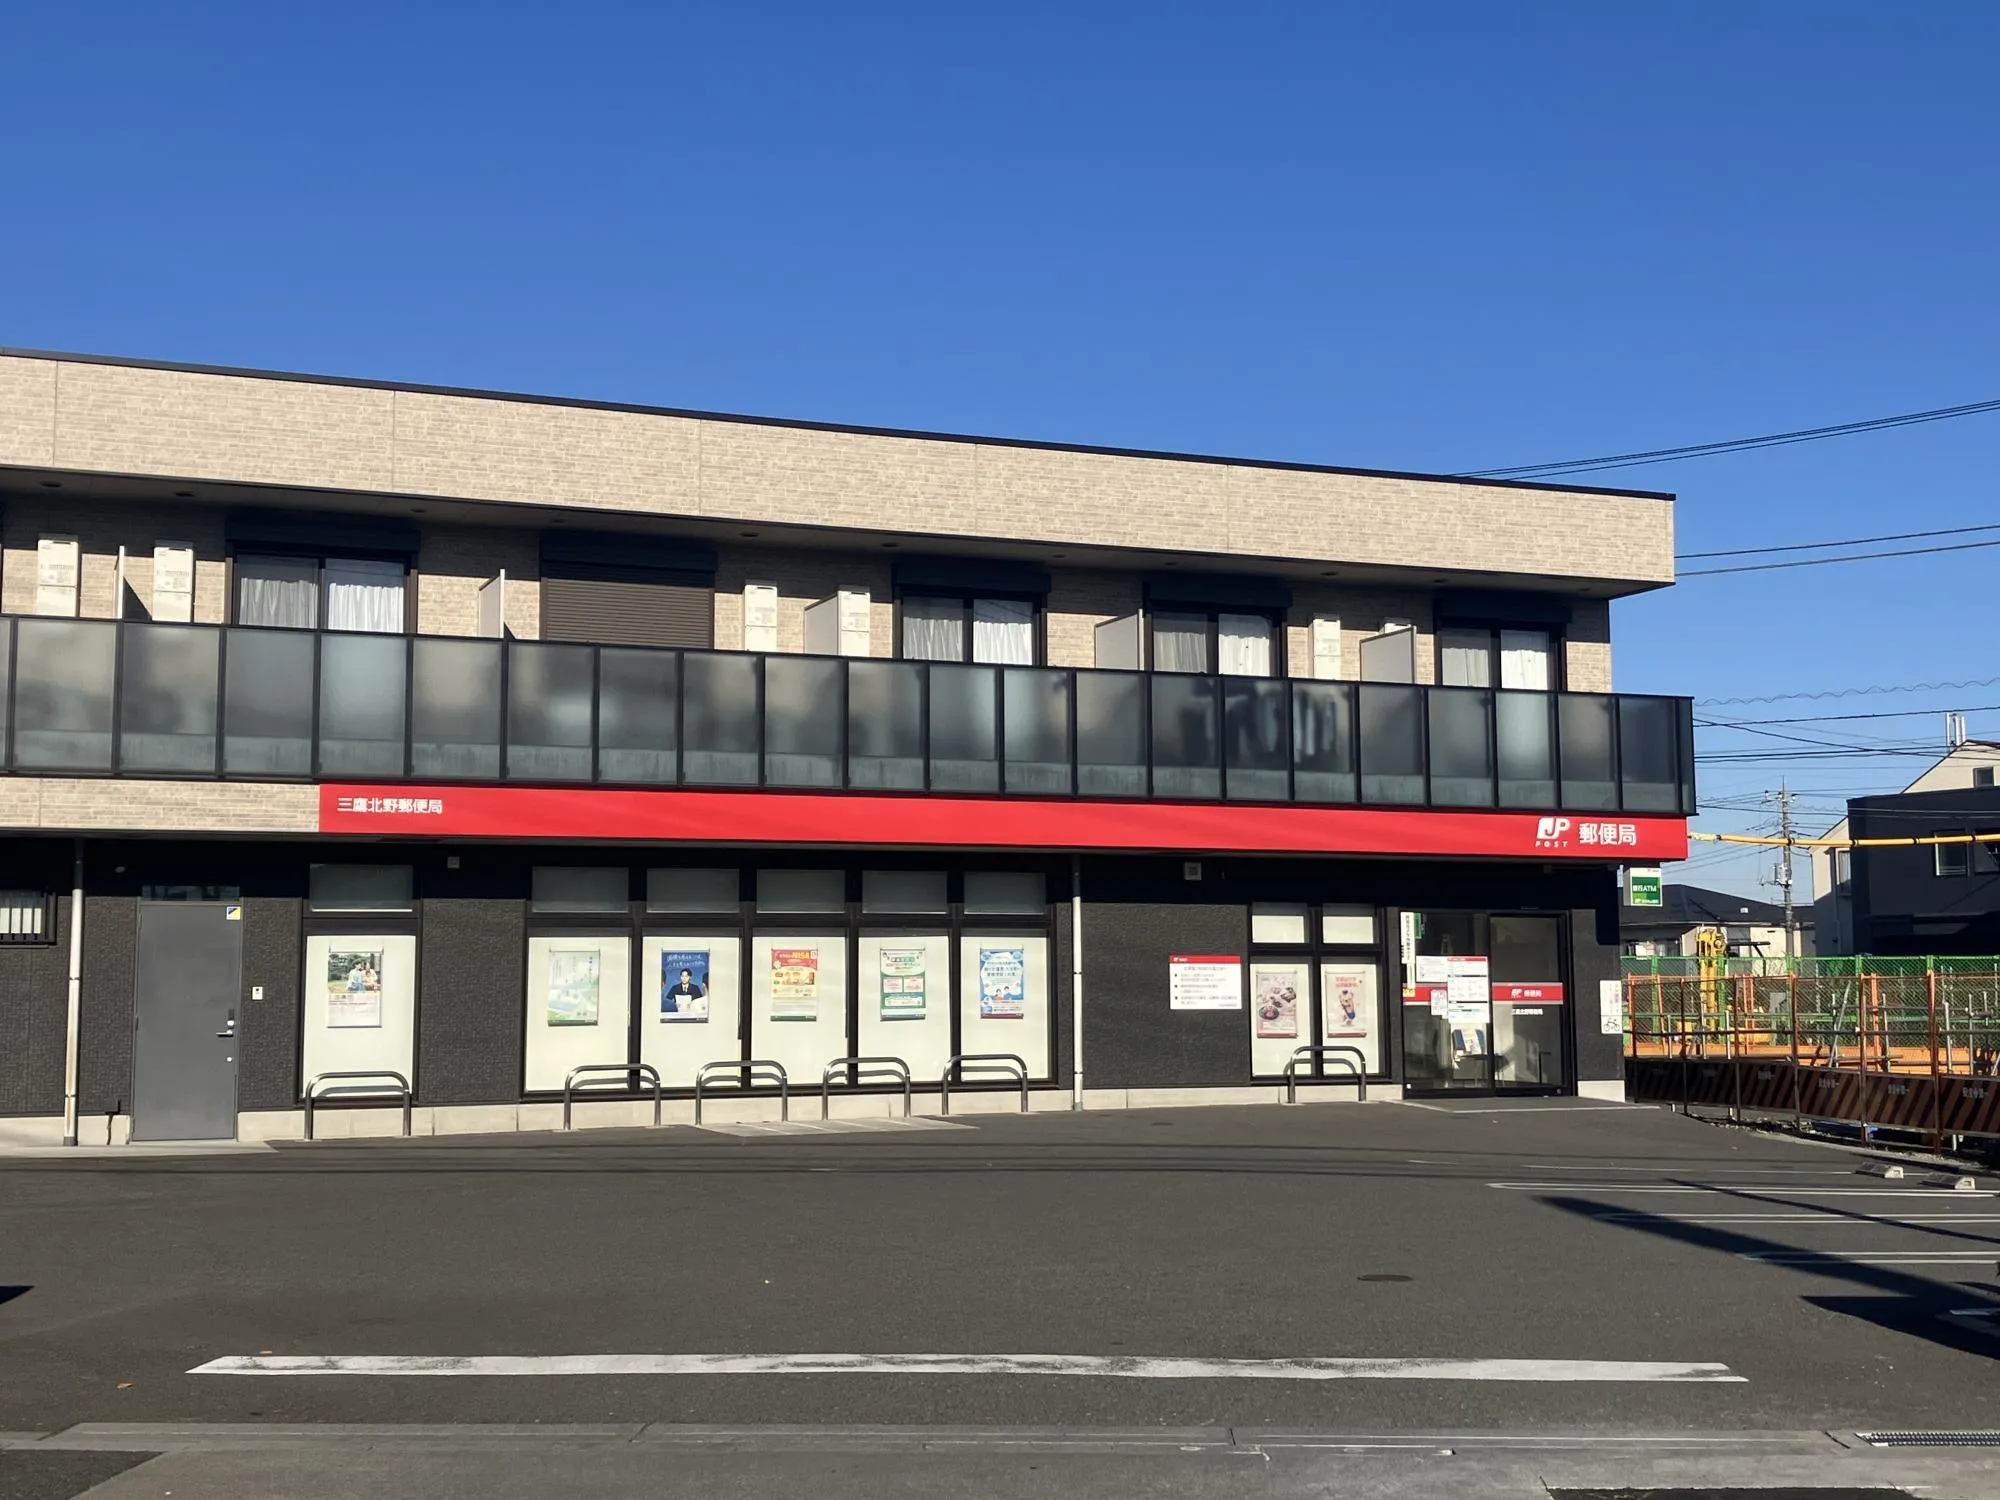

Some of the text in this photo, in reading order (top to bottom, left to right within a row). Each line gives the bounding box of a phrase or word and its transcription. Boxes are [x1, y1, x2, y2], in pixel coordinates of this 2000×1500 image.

[336, 797, 443, 814] 三鷹北野郵便局
[1579, 822, 1637, 846] 郵便局
[1535, 840, 1568, 848] POST
